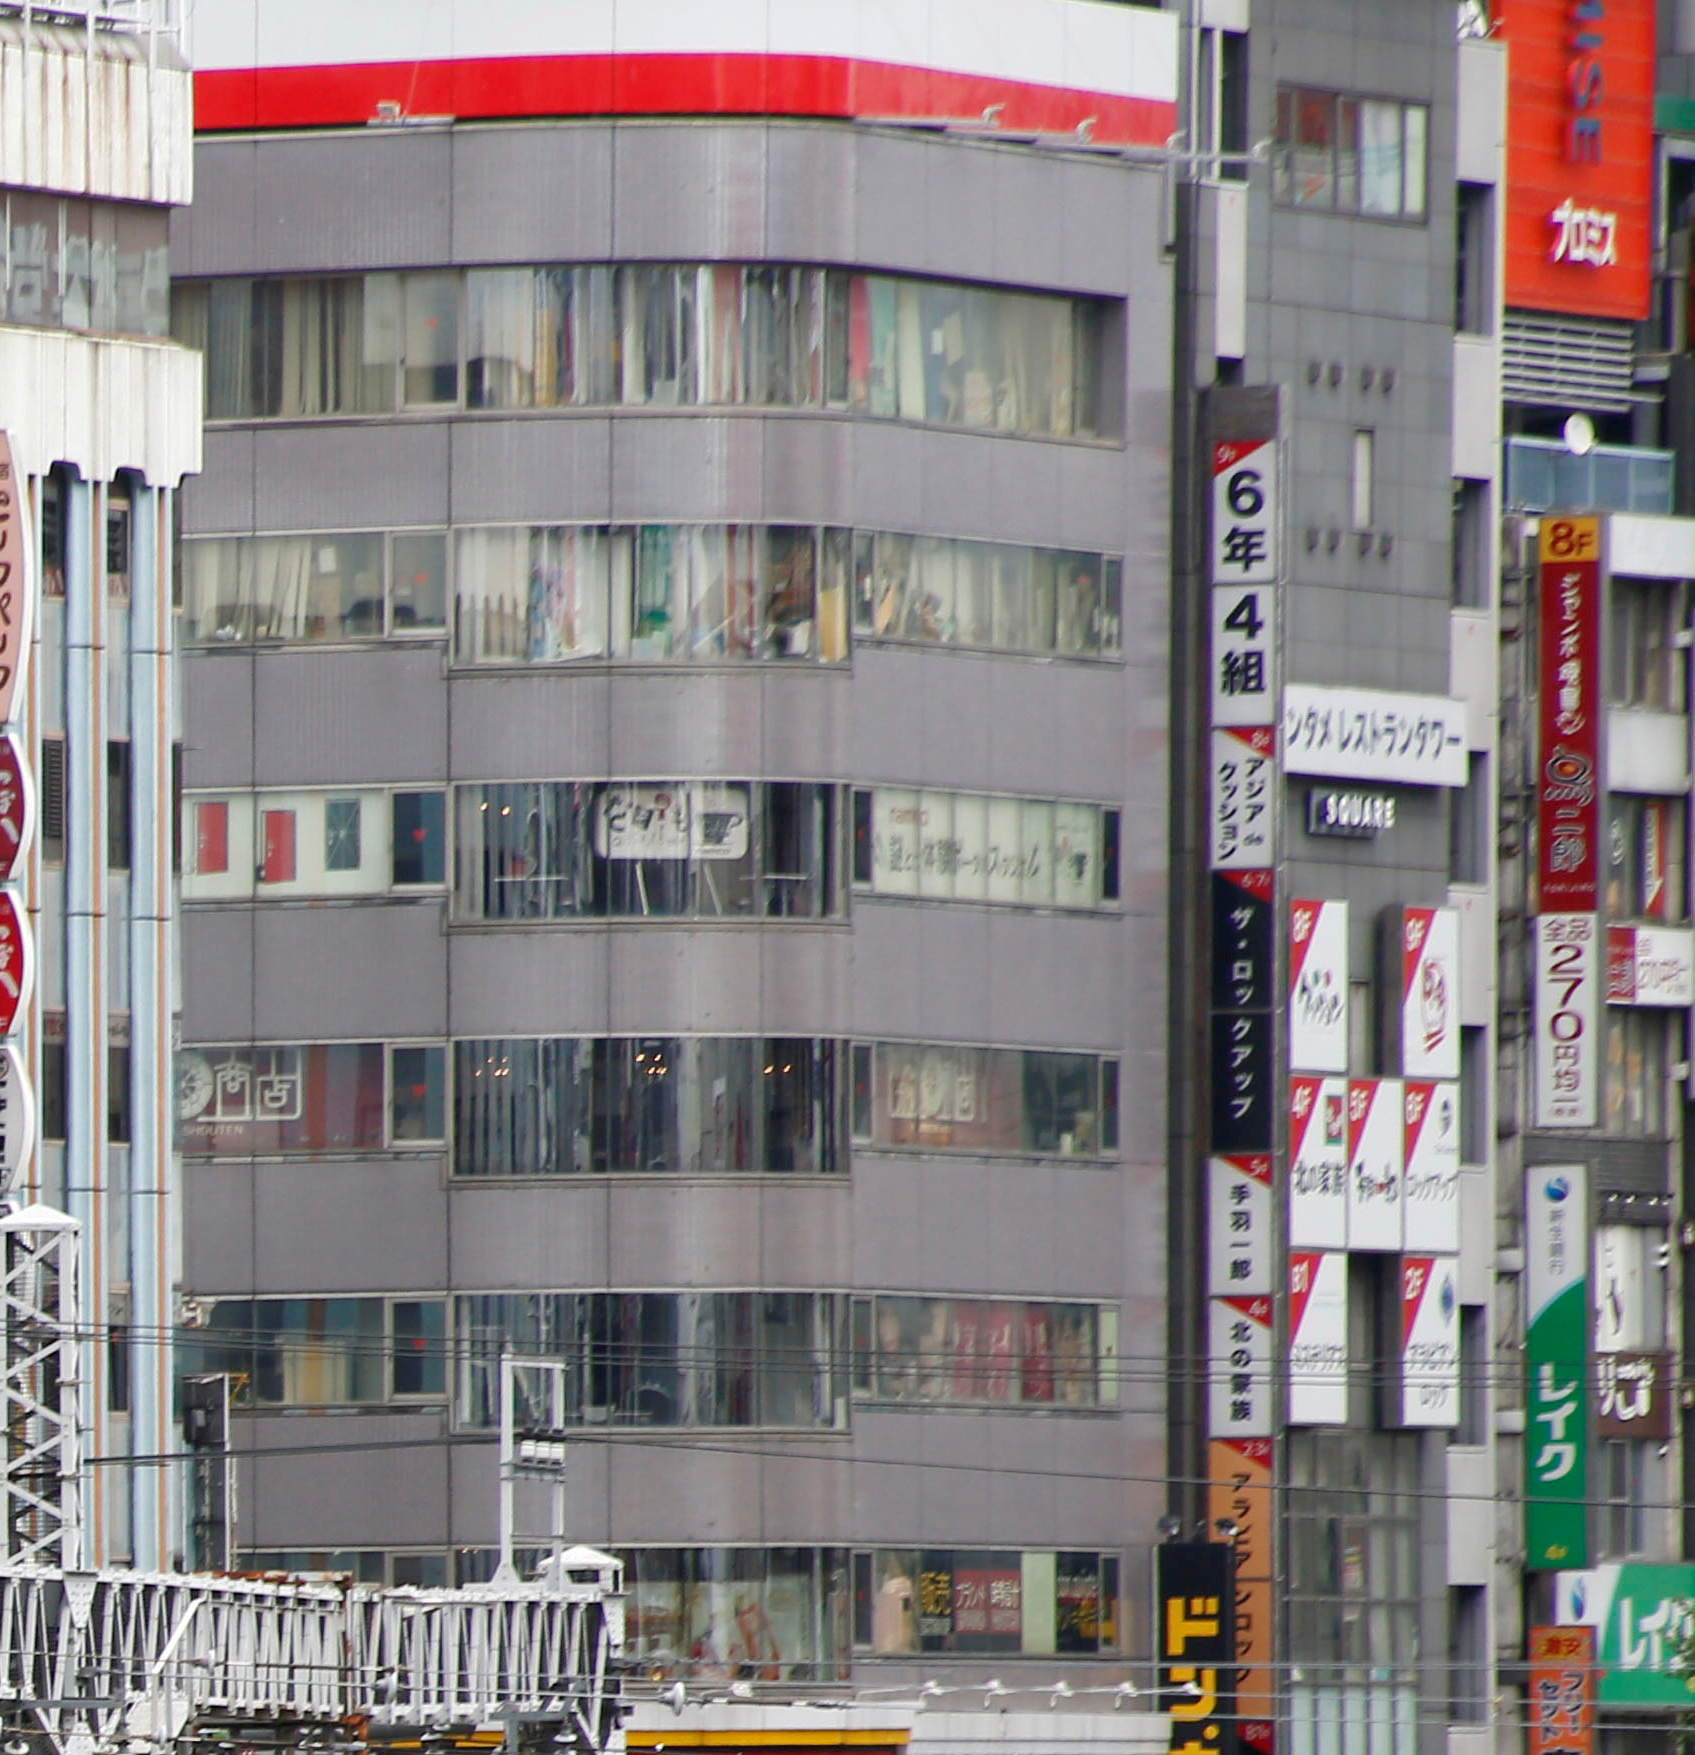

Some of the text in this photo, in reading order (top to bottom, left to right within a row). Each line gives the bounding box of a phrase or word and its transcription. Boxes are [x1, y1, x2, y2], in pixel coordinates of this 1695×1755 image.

[1551, 199, 1618, 269] プロミス
[1550, 522, 1594, 556] 8F
[1221, 468, 1267, 697] 6年4組
[1244, 758, 1265, 824] アジア
[1322, 792, 1396, 830] SQUARE
[1543, 917, 1592, 942] 全品
[1228, 1183, 1253, 1282] 手羽一郎
[1228, 1320, 1253, 1423] 北の家族
[1532, 1362, 1578, 1482] レイク
